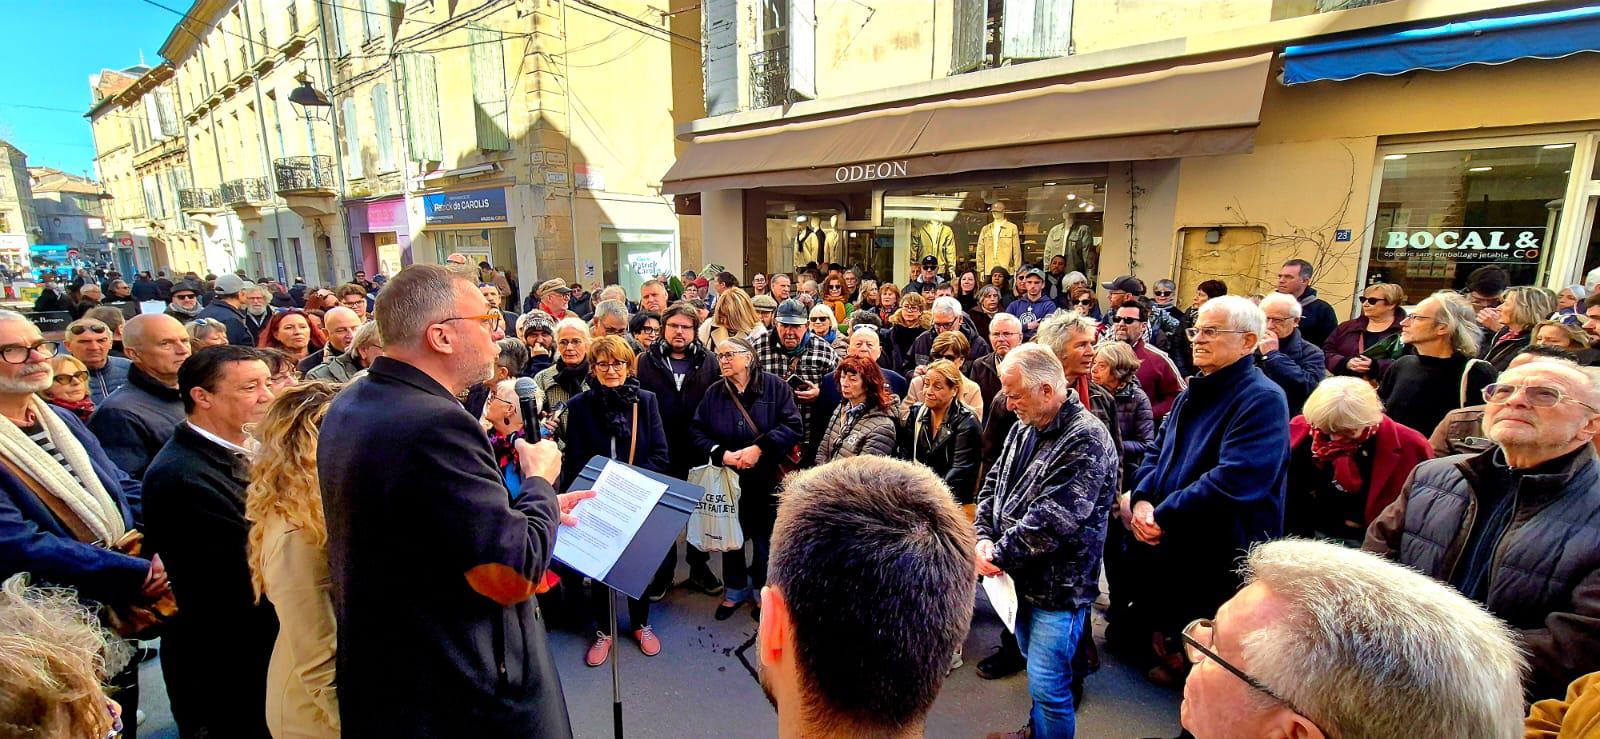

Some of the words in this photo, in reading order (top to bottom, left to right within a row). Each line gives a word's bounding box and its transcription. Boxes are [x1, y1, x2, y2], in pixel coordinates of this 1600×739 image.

[835, 161, 908, 182] ODEON
[461, 199, 489, 209] CAROLIS
[1385, 231, 1510, 249] BOCAL
[1515, 231, 1539, 248] &
[1434, 251, 1478, 259] emballage
[1478, 251, 1509, 259] jetable
[705, 493, 715, 503] CE
